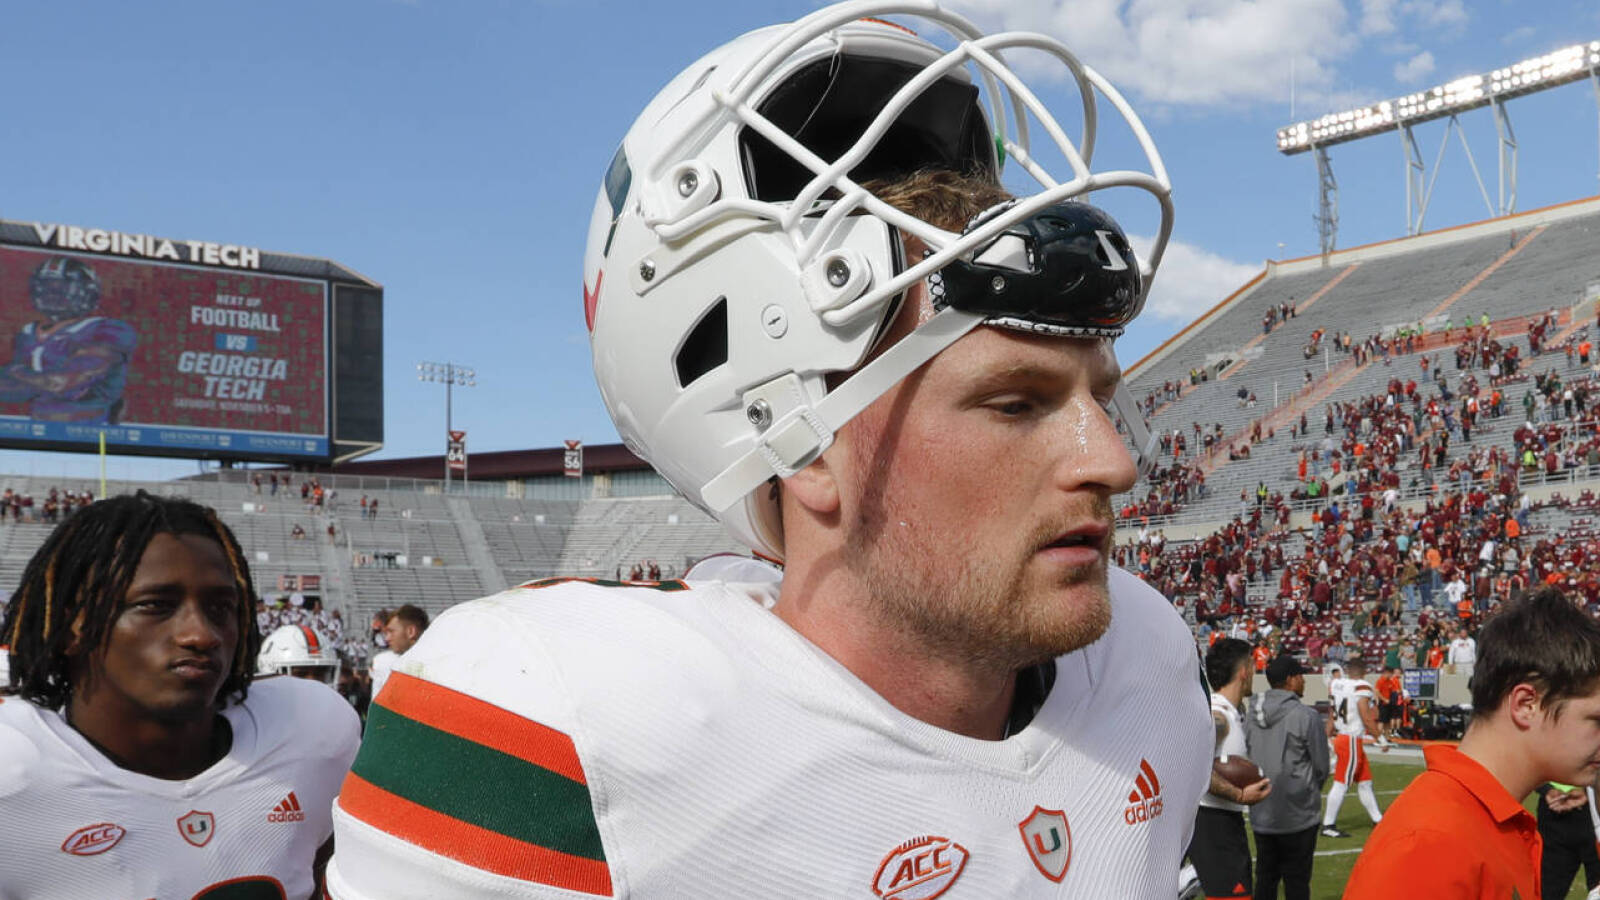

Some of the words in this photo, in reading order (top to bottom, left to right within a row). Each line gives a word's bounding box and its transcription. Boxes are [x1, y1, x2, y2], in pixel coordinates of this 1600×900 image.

[33, 222, 180, 260] VIRGINIA
[187, 240, 260, 269] TECH
[216, 294, 244, 306] NEXT
[191, 305, 281, 332] FOOTBALL
[226, 334, 249, 351] VS
[177, 350, 288, 381] GEORGIA
[204, 375, 267, 401] TECH
[564, 456, 580, 469] 56
[267, 811, 305, 823] adidas
[1124, 800, 1164, 826] adidas
[73, 827, 117, 849] ACC
[1033, 827, 1061, 855] U
[888, 844, 952, 889] ACC
